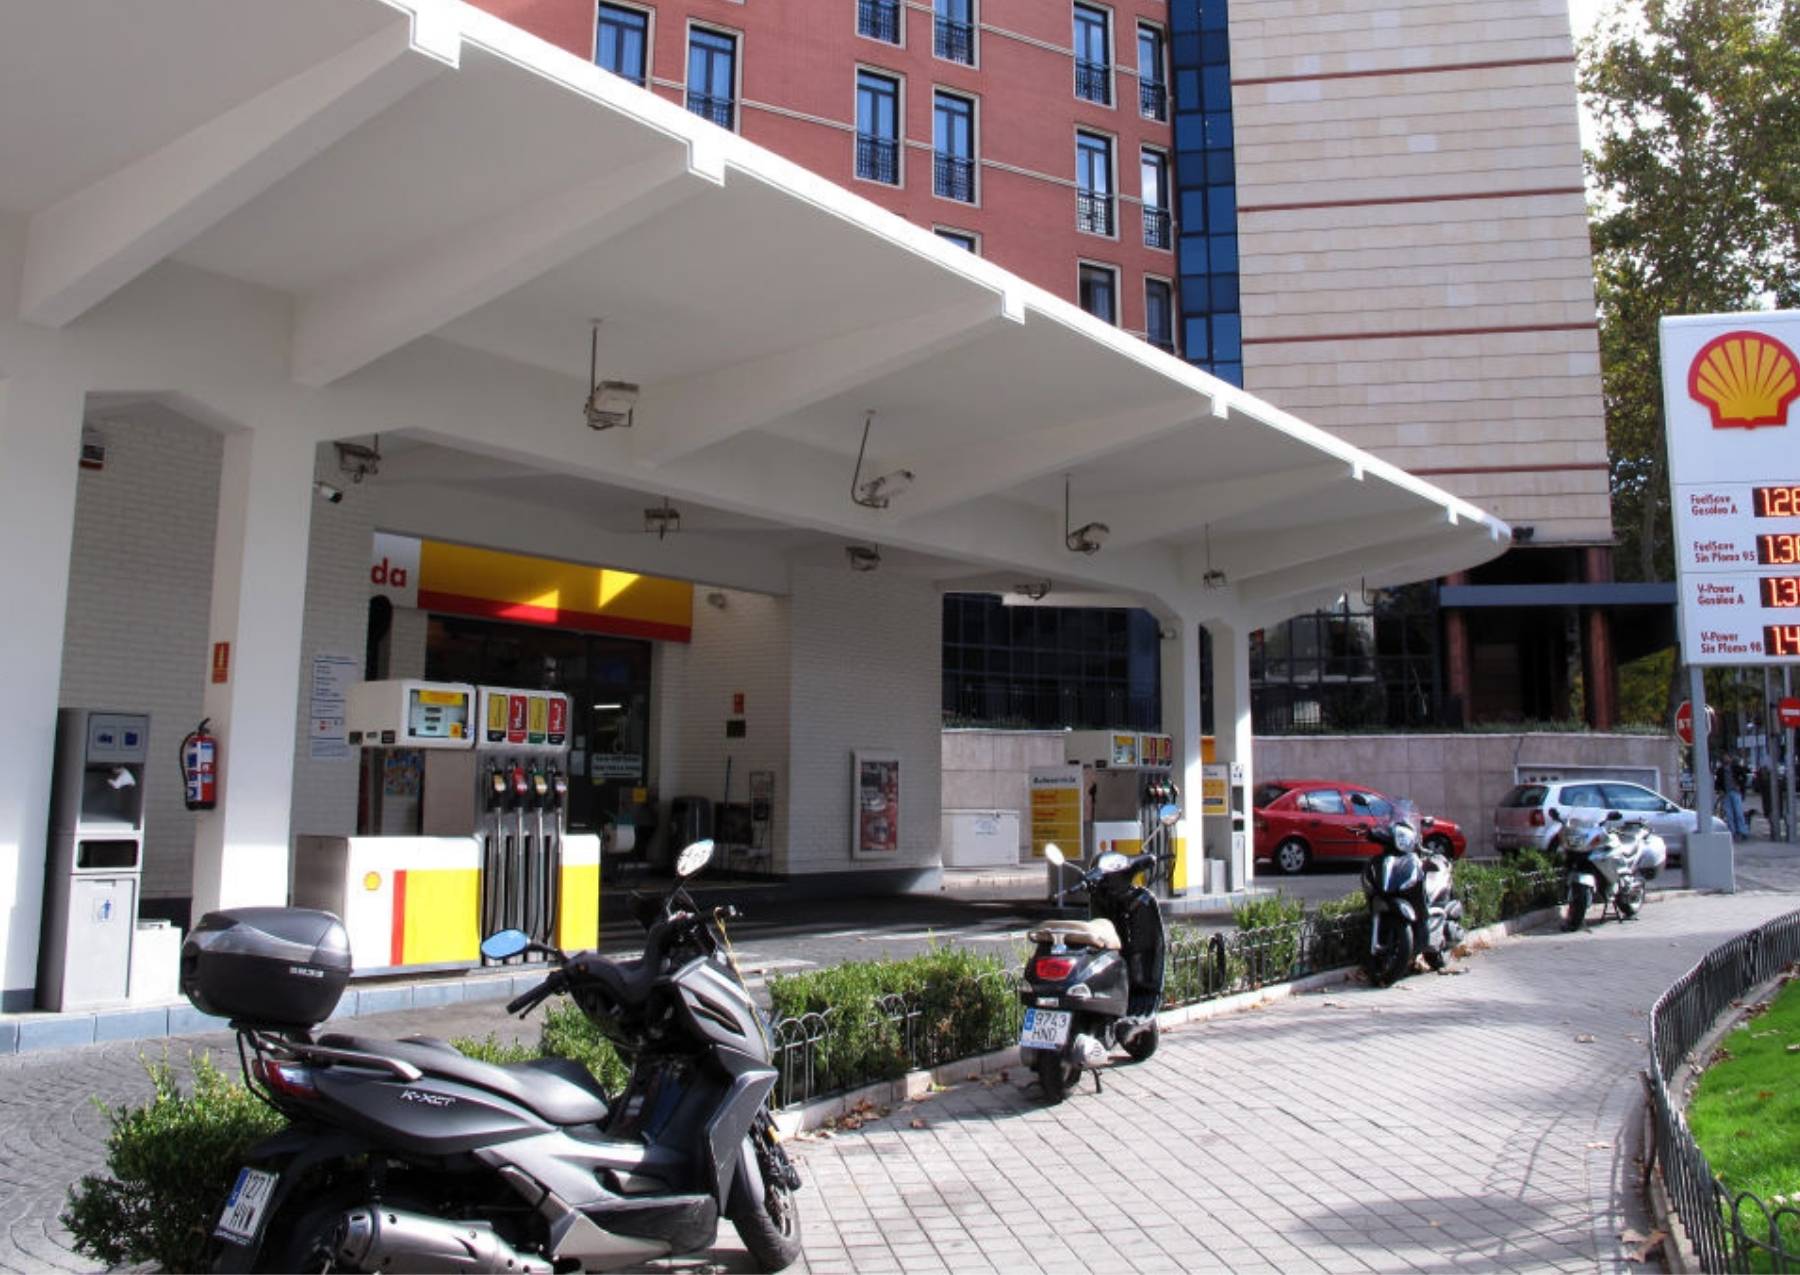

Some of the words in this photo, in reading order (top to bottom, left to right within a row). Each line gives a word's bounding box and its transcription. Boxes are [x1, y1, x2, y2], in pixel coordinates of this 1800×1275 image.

[1730, 502, 1738, 514] A
[1765, 535, 1800, 563] 1.3
[1695, 552, 1709, 563] Sin
[1742, 550, 1756, 561] 95
[1697, 583, 1735, 594] V-Power
[1737, 593, 1745, 605] A
